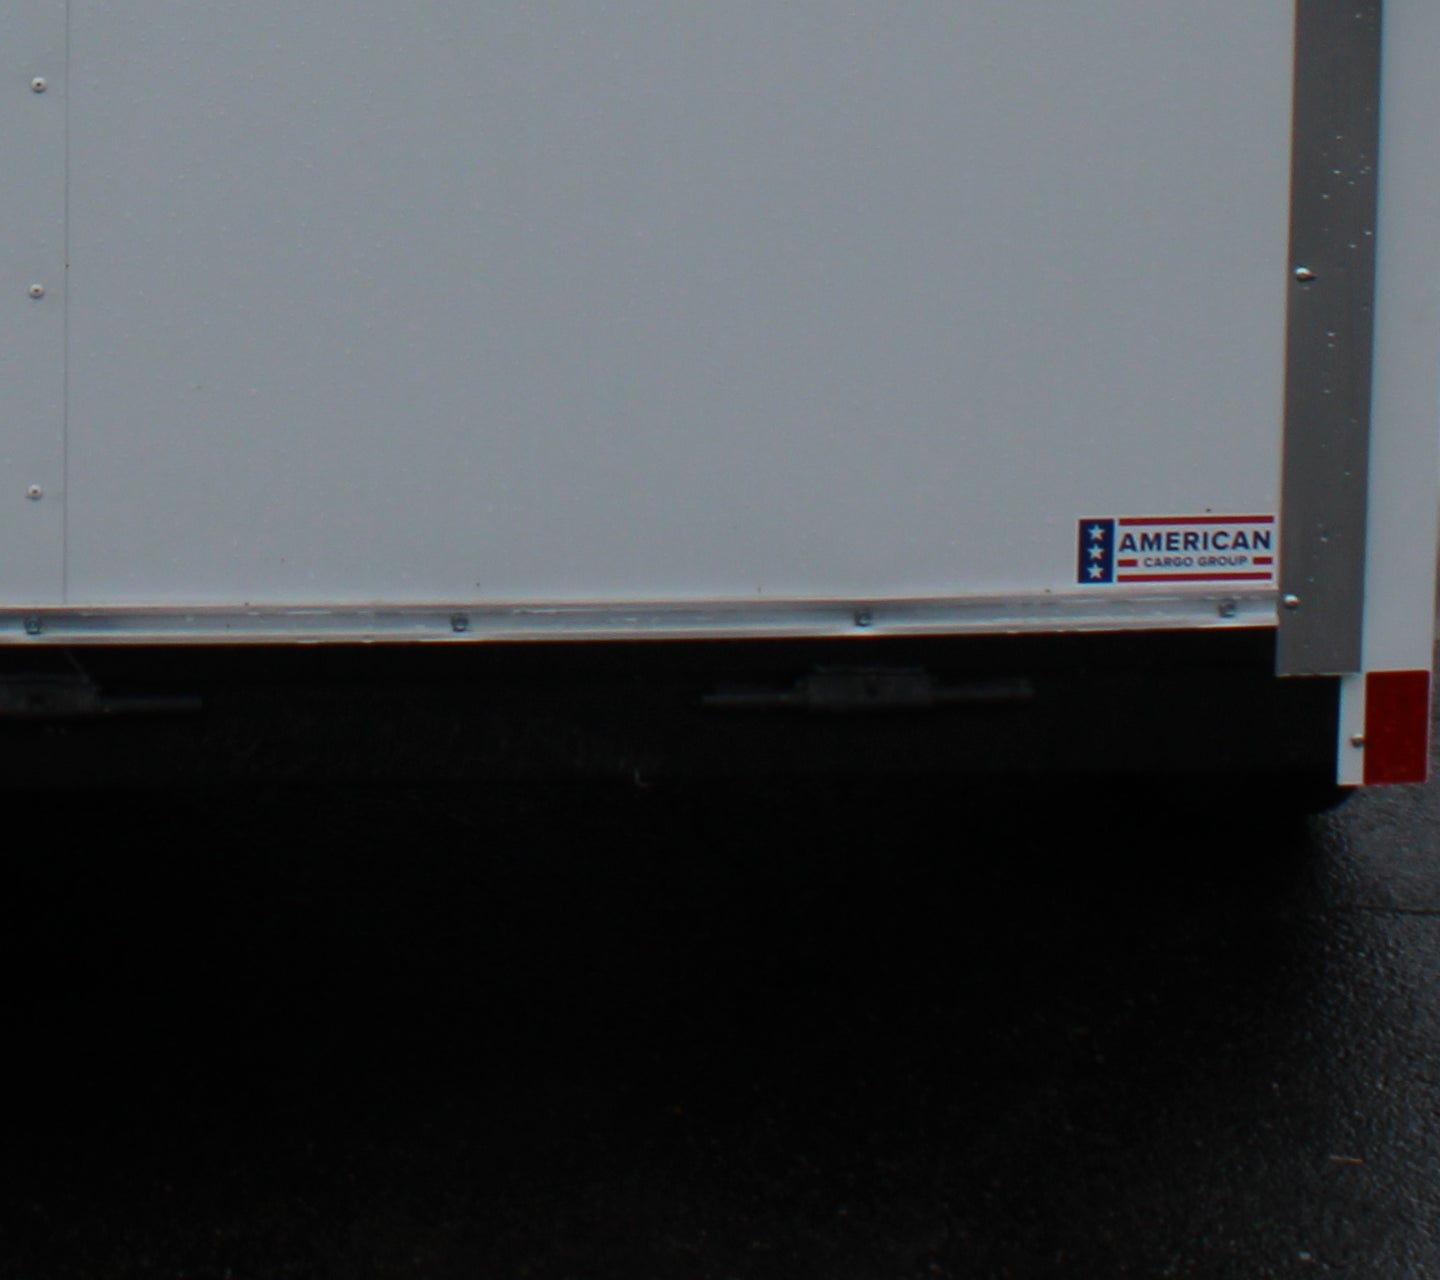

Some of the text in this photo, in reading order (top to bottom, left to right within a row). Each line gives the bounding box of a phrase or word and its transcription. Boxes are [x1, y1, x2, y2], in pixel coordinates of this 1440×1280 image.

[1120, 530, 1271, 552] AMERICAN
[1143, 556, 1248, 567] CARGO GROUP
